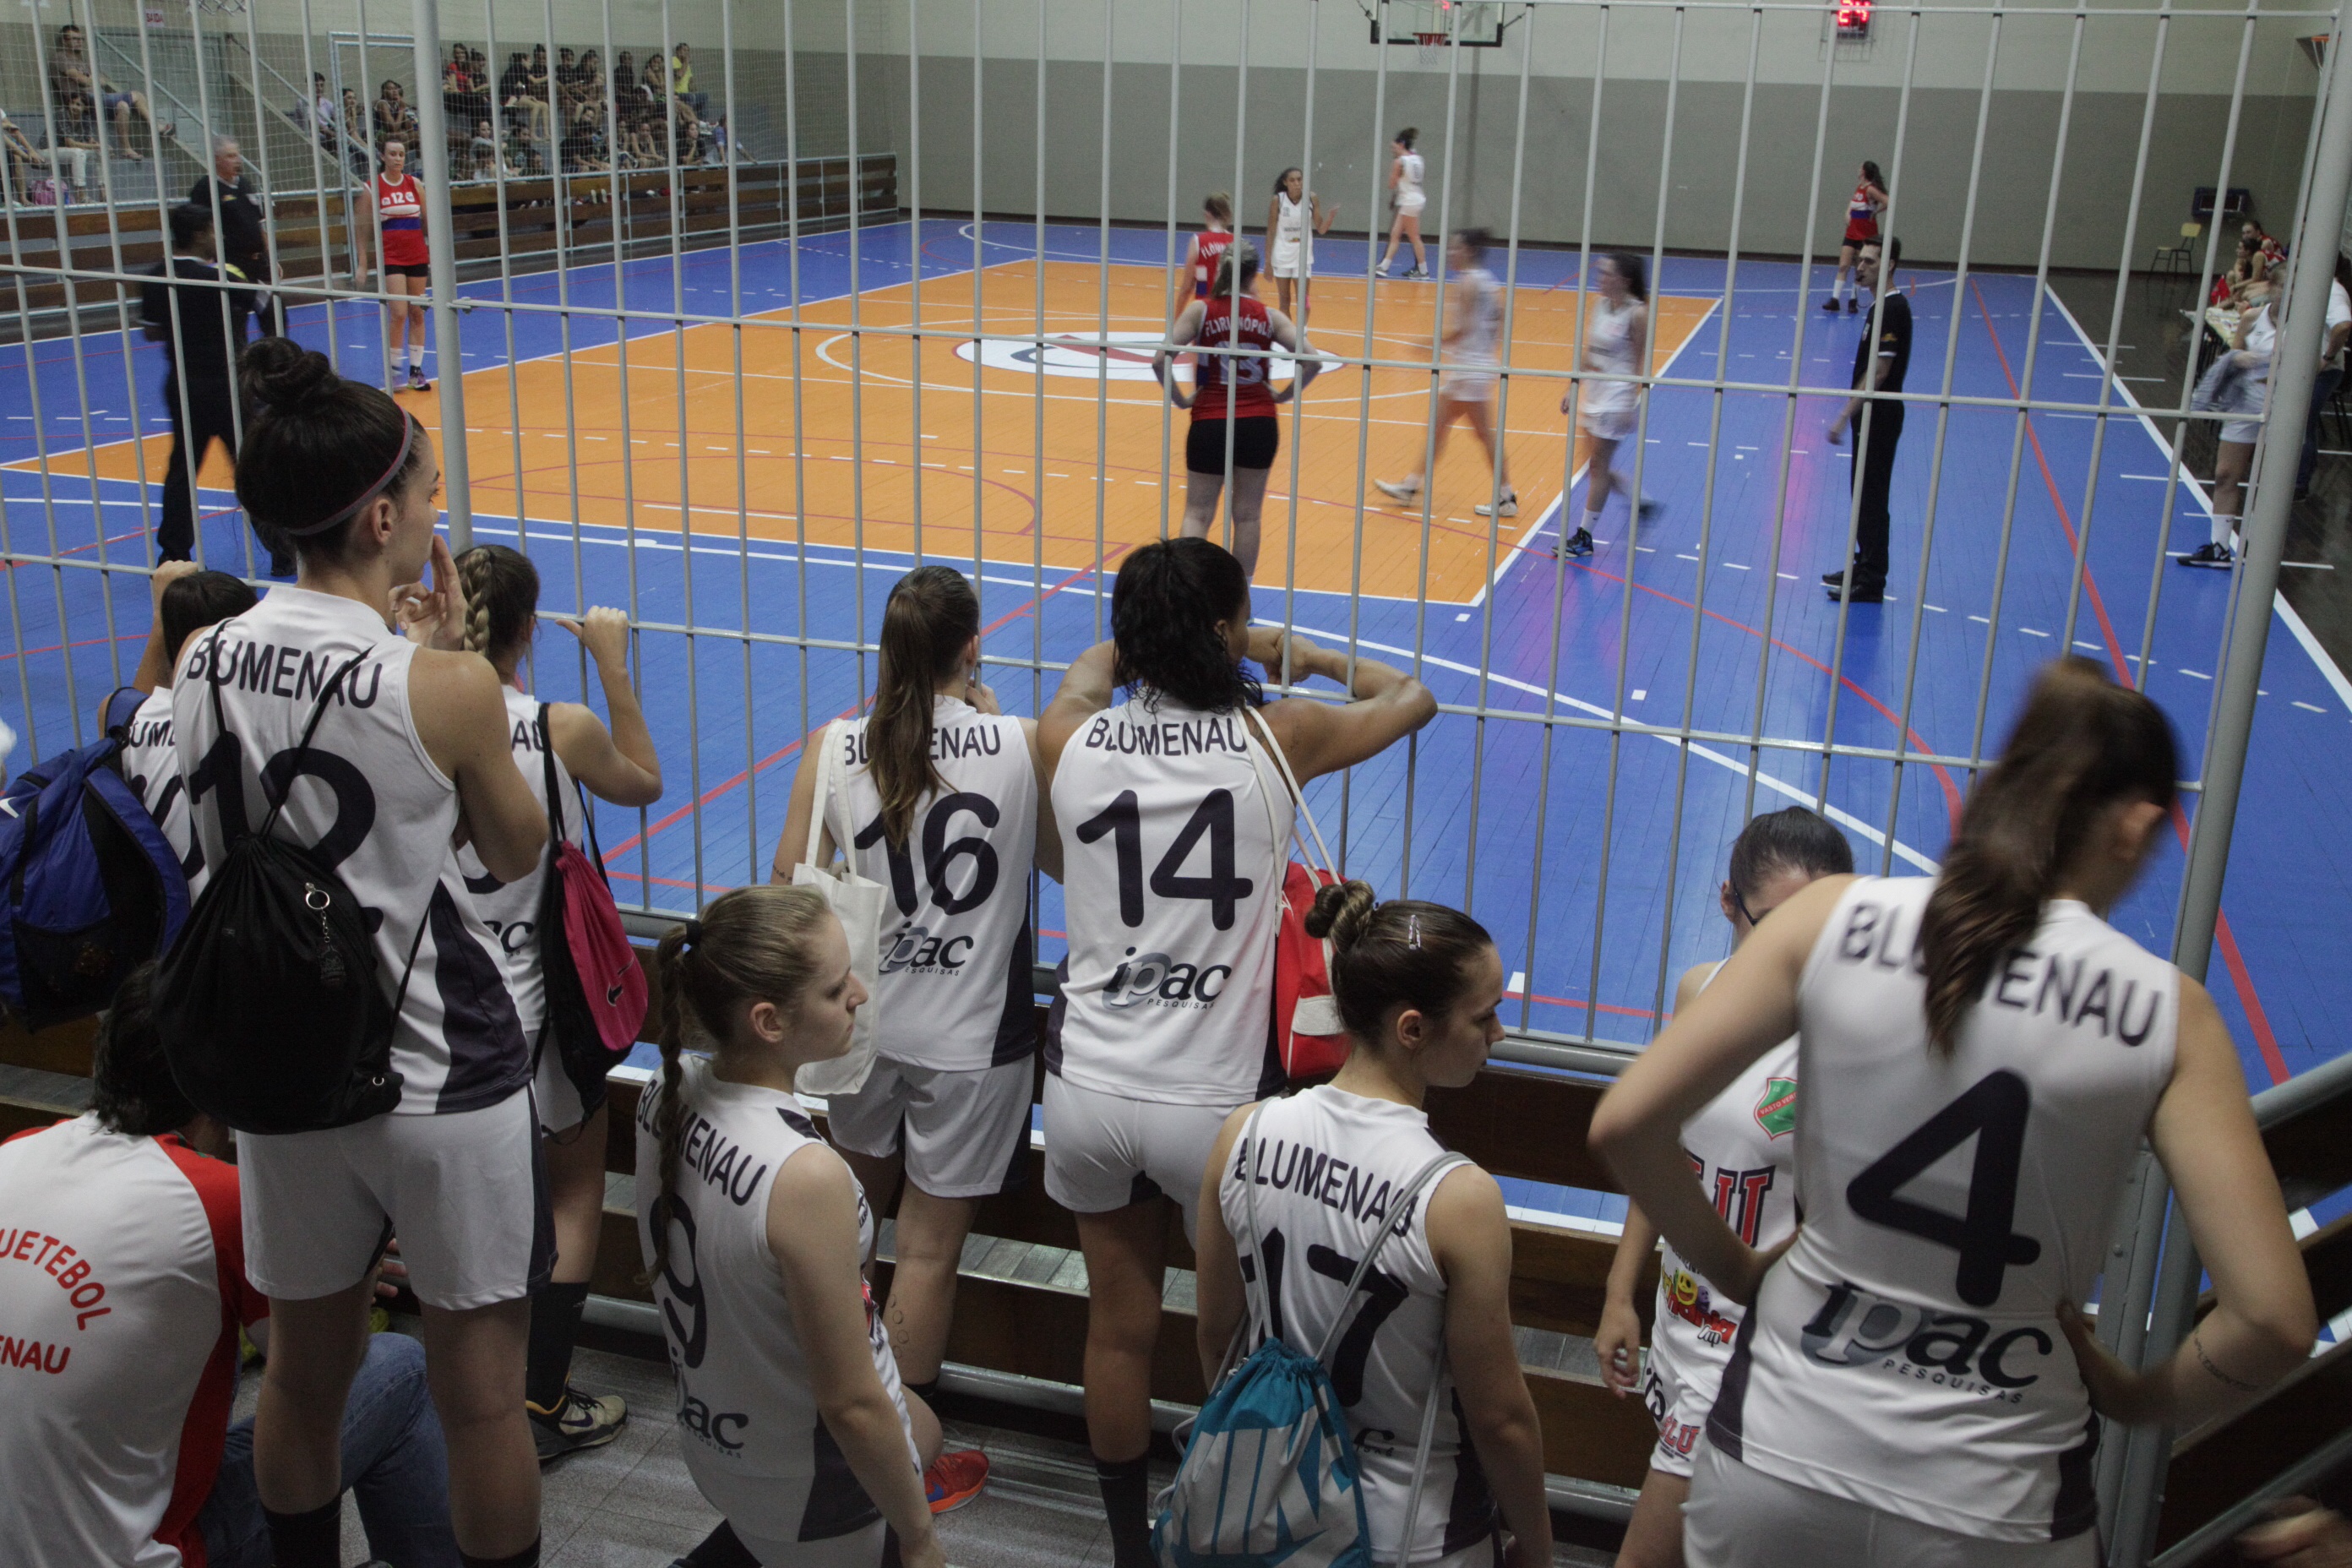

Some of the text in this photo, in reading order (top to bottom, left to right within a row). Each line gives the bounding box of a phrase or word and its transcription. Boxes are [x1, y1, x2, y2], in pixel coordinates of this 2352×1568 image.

[391, 192, 406, 204] 12
[1214, 340, 1263, 384] 13
[845, 724, 1002, 766] BLENAU
[1085, 716, 1249, 756] BLUMENAU
[853, 791, 999, 917] 16
[1075, 787, 1254, 931] 14
[878, 920, 975, 974] ipac
[1102, 945, 1233, 1010] ipac
[1838, 902, 2164, 1048] BLENAU
[1146, 997, 1215, 1010] PESQUISAS
[1759, 1100, 1782, 1115] VASTO
[637, 1078, 767, 1207] BLENAU
[1846, 1066, 2041, 1308] 4
[649, 1191, 708, 1369] 9
[1239, 1227, 1409, 1407] 17
[1801, 1280, 2053, 1388] ipac
[1882, 1358, 2023, 1403] PESQUISAS
